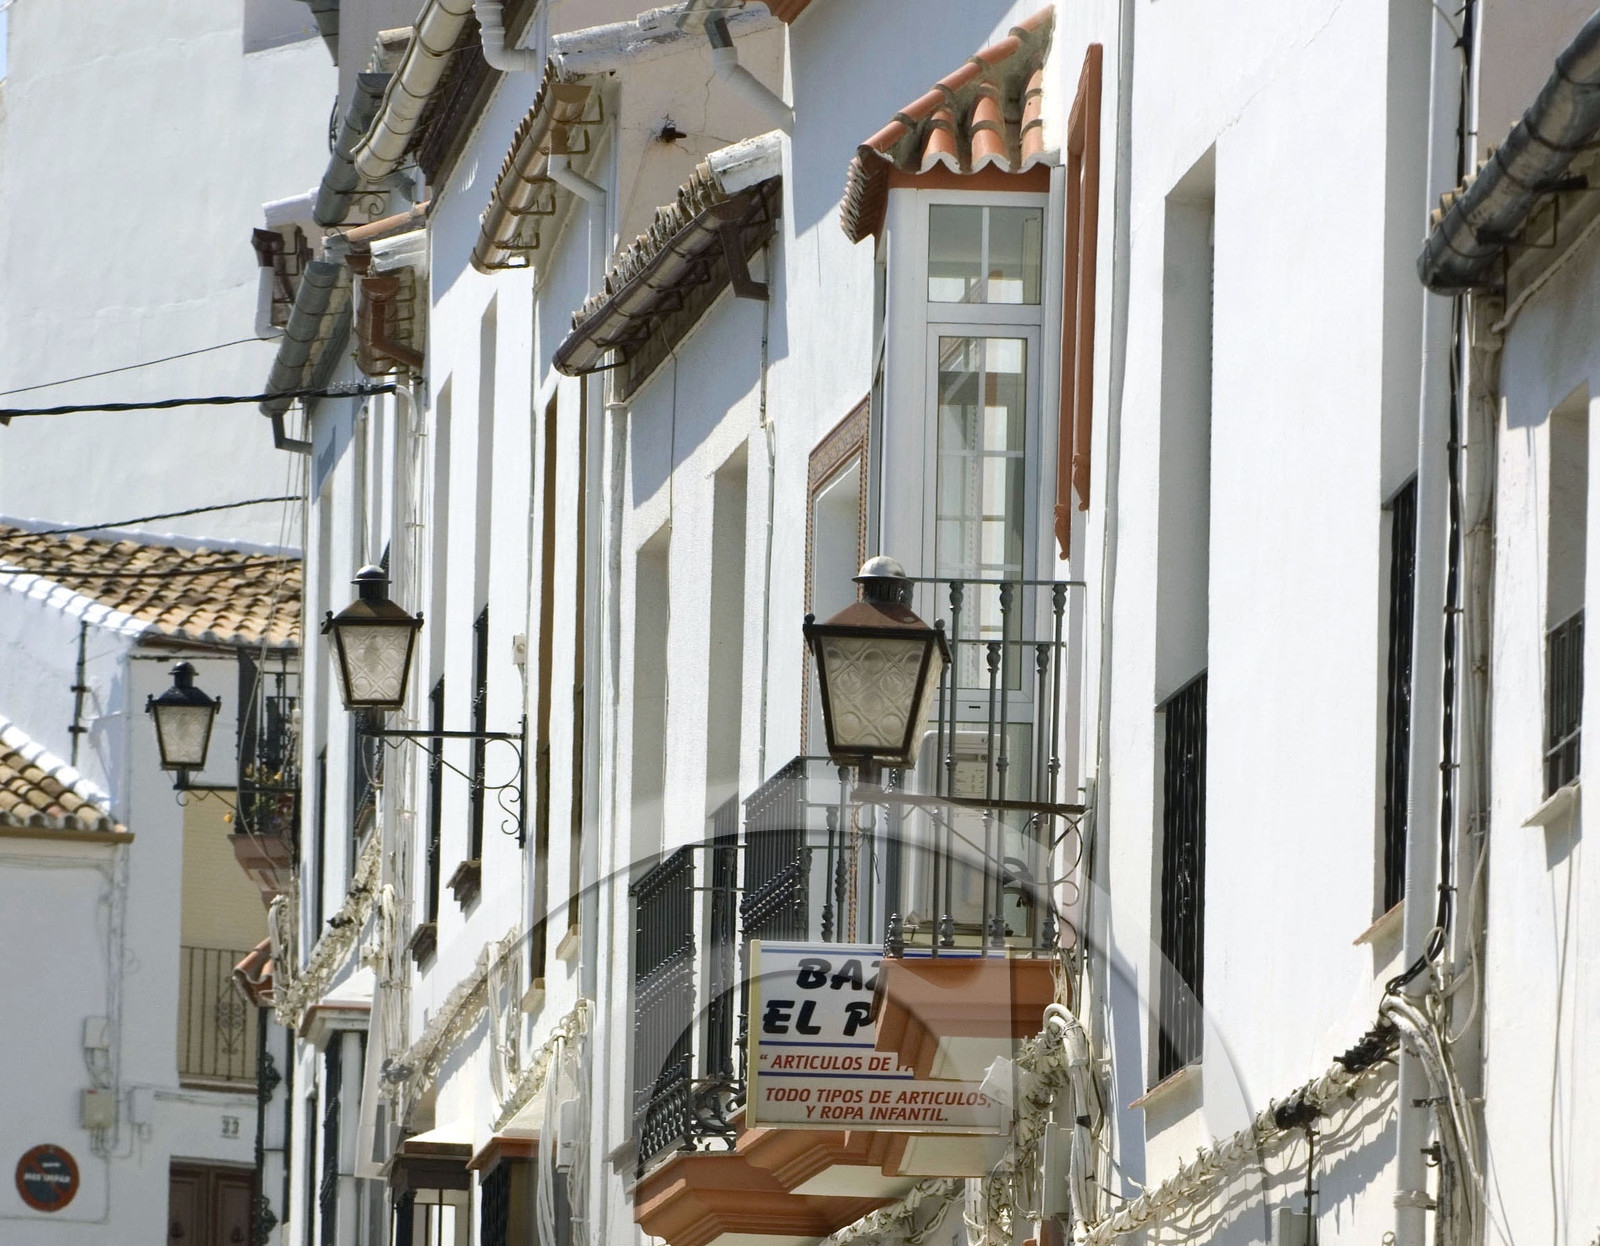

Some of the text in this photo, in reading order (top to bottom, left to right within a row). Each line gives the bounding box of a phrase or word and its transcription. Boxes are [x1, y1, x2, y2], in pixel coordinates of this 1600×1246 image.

[762, 999, 822, 1035] EL
[770, 1054, 863, 1072] ARTICULOS
[867, 1056, 892, 1072] DE
[765, 1087, 992, 1109] TODO TIPOS DE ARTICULOS,
[805, 1105, 949, 1122] Y ROPA INFANTIL.
